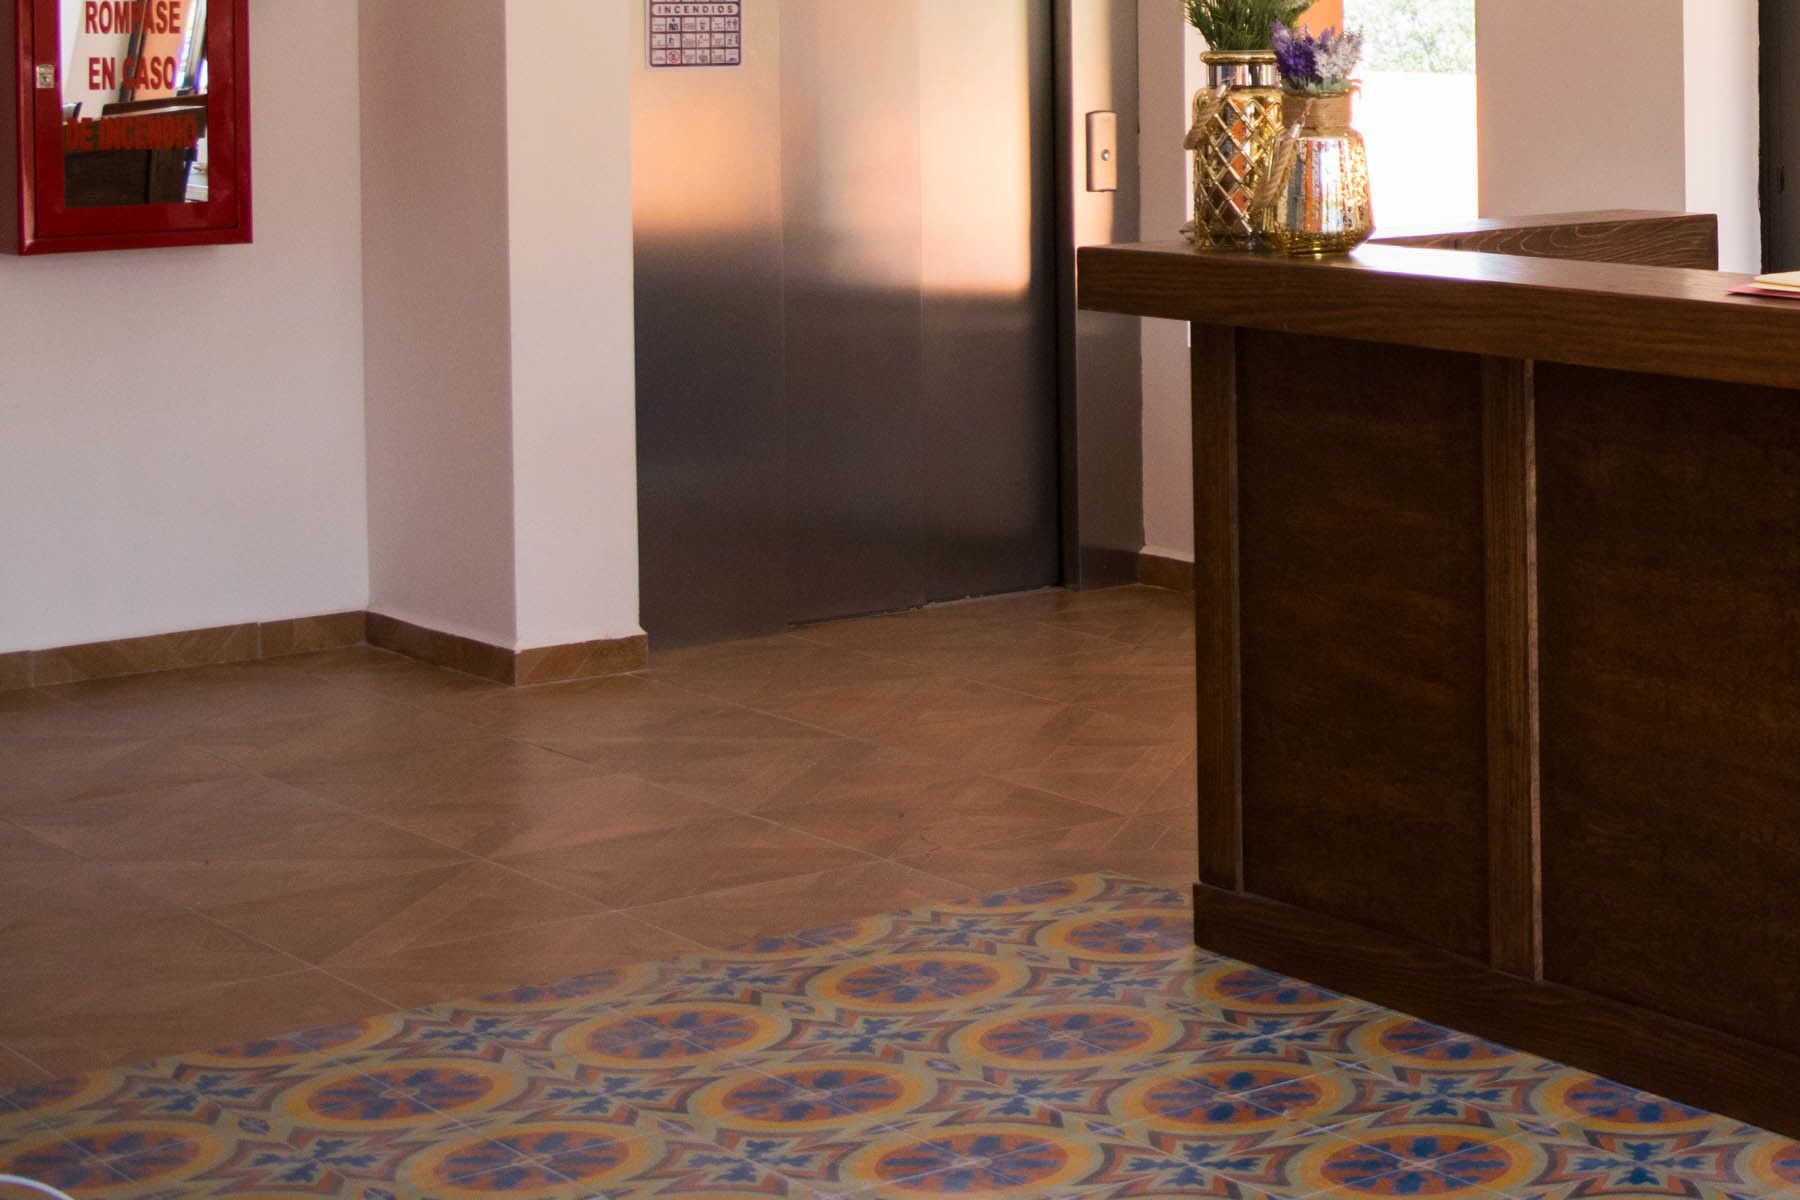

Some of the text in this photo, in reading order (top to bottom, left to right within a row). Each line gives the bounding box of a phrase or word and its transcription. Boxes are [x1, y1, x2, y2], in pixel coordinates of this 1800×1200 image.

[85, 0, 182, 34] ROMPASE
[658, 4, 734, 13] INCENDIOS
[88, 56, 177, 90] EN CASO
[65, 117, 94, 150] DE
